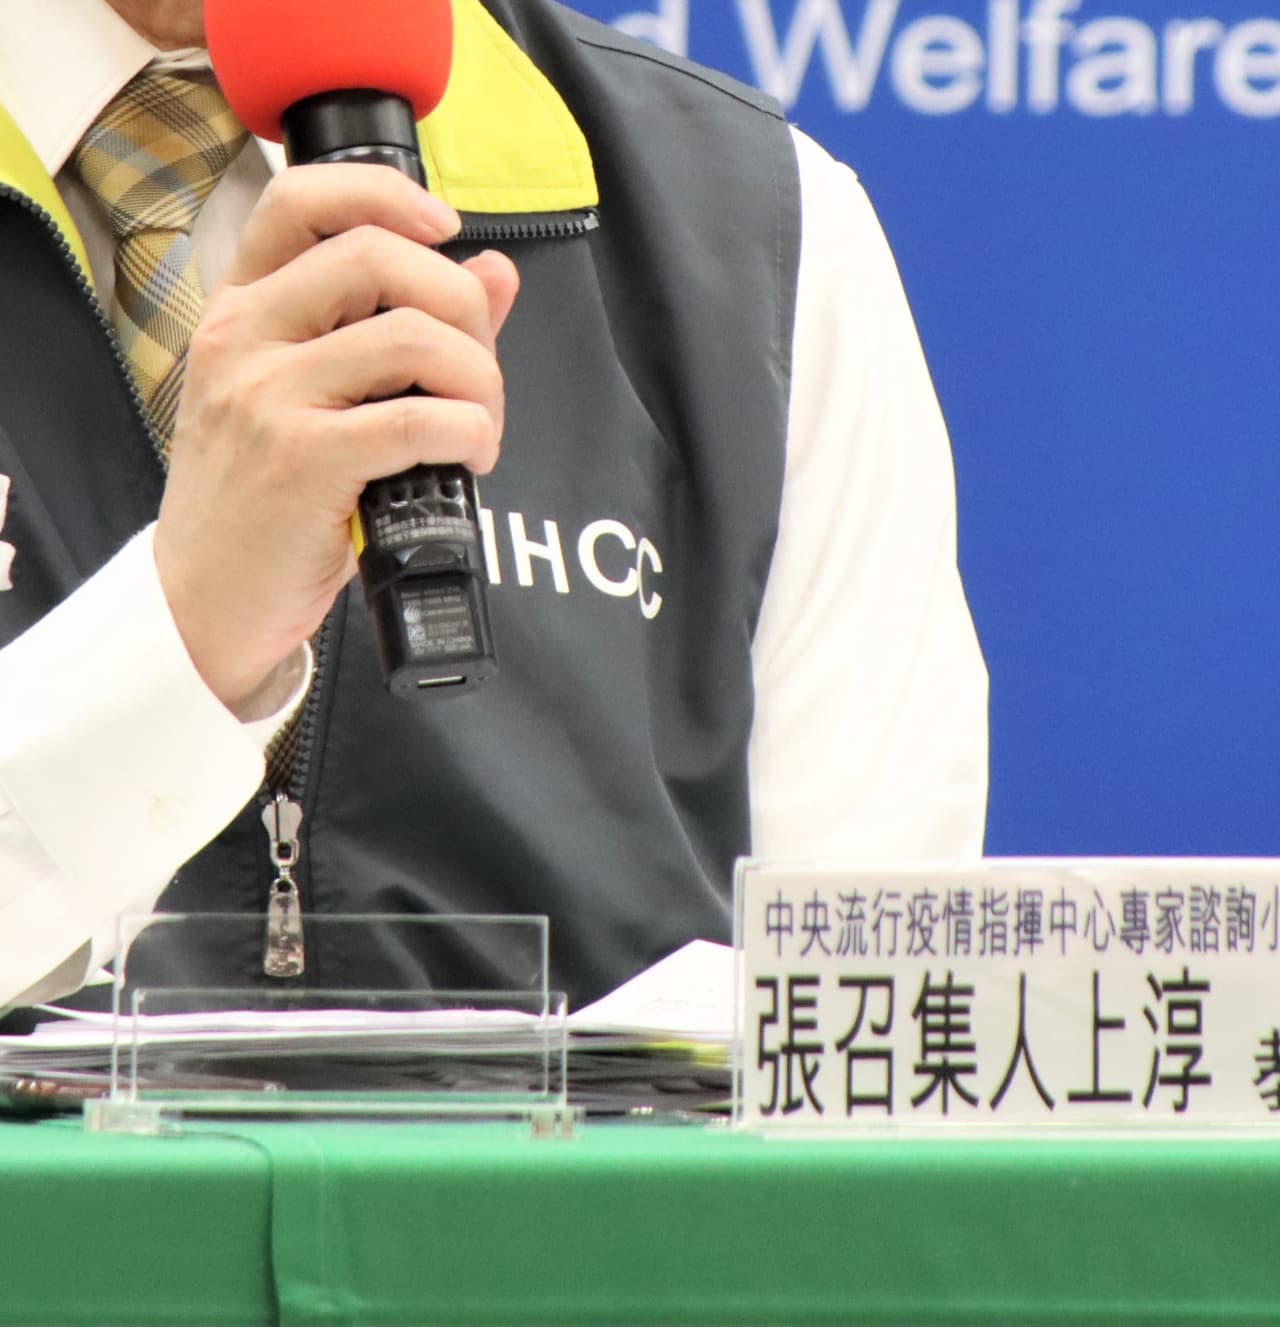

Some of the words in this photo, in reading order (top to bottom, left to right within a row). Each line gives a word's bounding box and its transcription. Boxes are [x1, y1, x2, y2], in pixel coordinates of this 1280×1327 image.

[755, 965, 1213, 1117] 張召集人上淳
